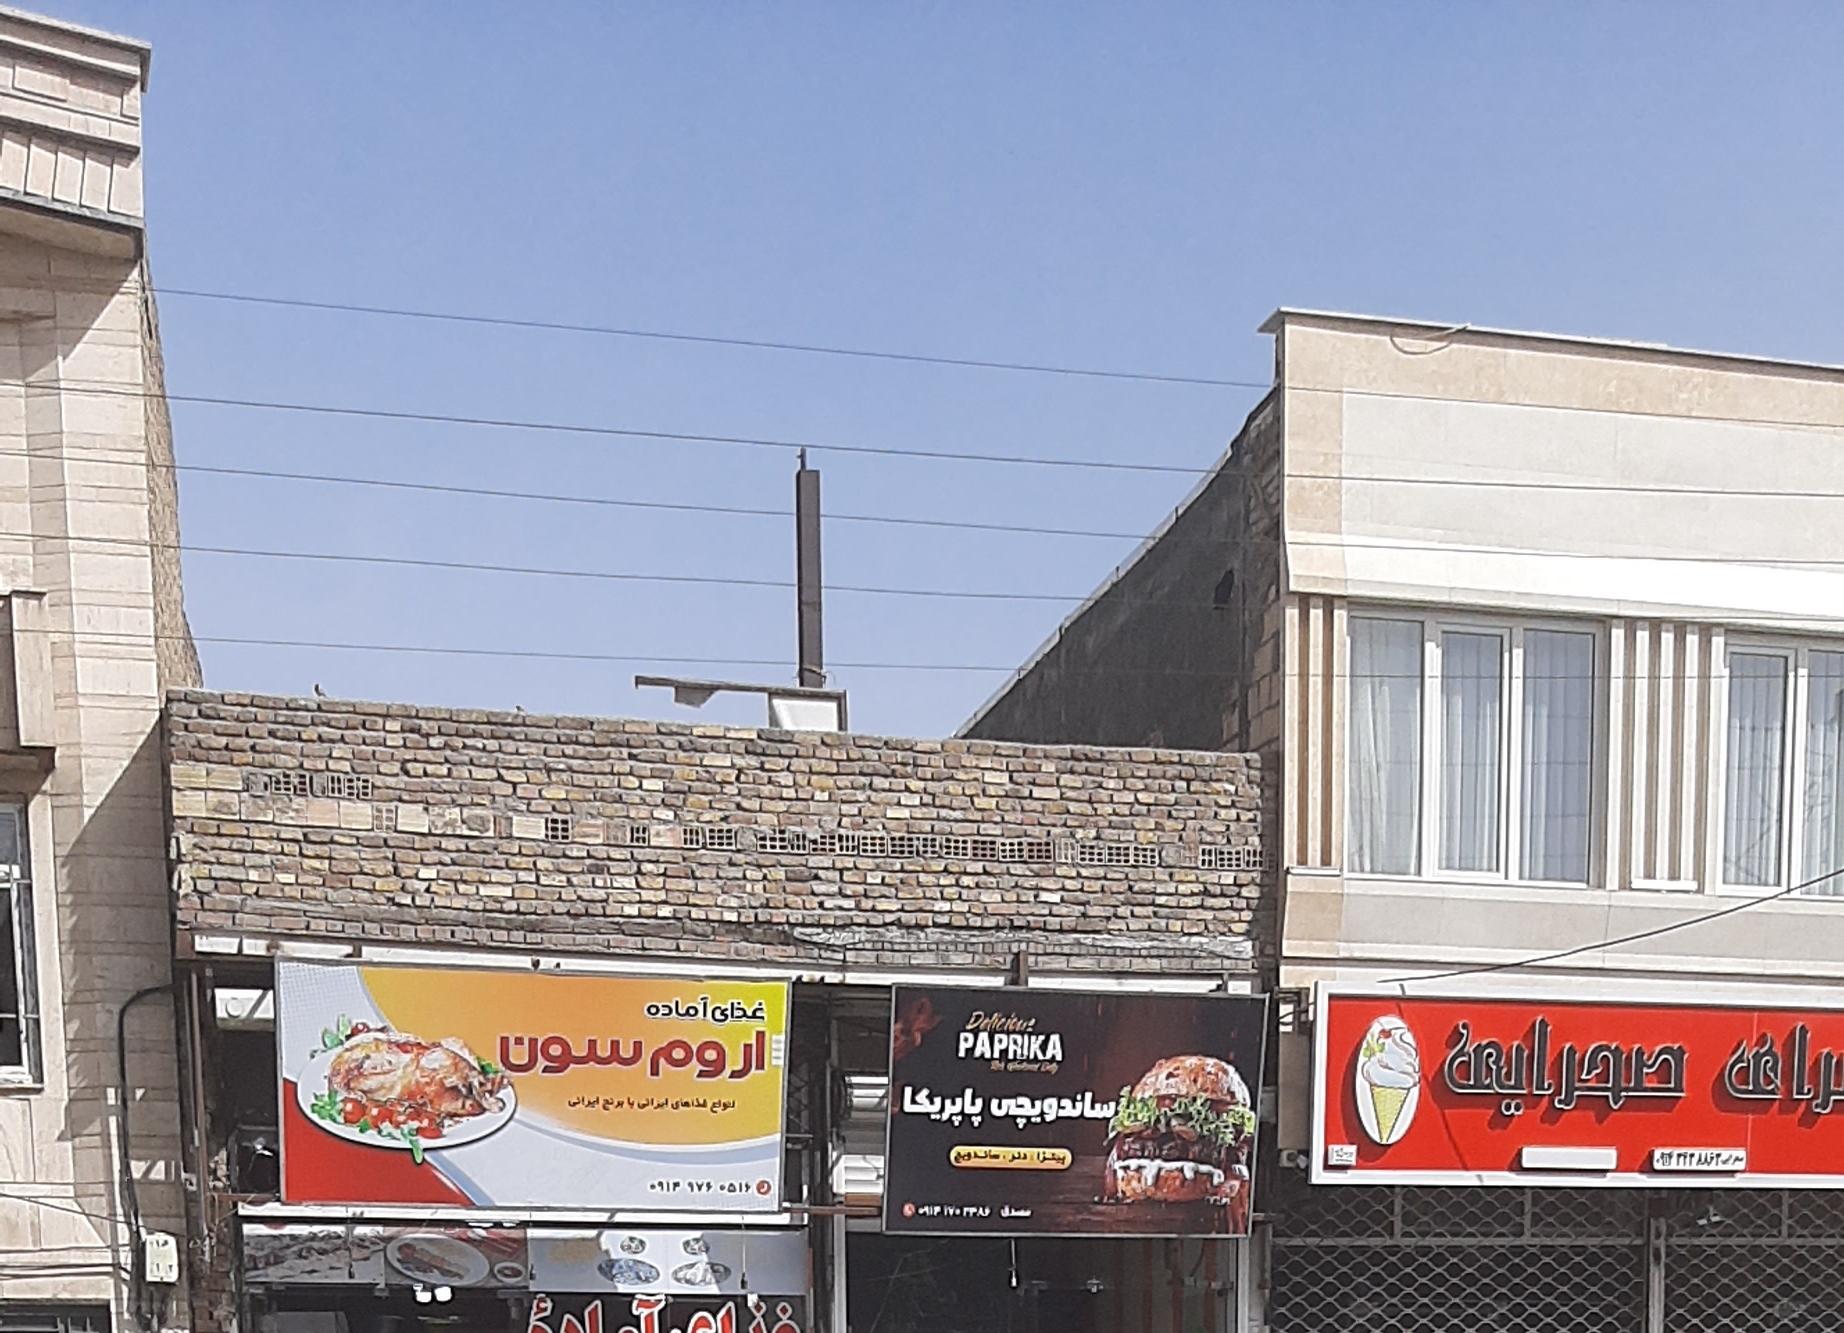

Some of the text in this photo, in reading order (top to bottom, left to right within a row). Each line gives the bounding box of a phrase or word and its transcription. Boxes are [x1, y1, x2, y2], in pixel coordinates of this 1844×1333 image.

[646, 996, 765, 1023] غذای آماده
[499, 1035, 643, 1077] سون
[650, 1030, 766, 1079] اروم
[958, 1031, 1063, 1061] PAPRIKA
[902, 1086, 1117, 1129] ساندویچی پاپریکا
